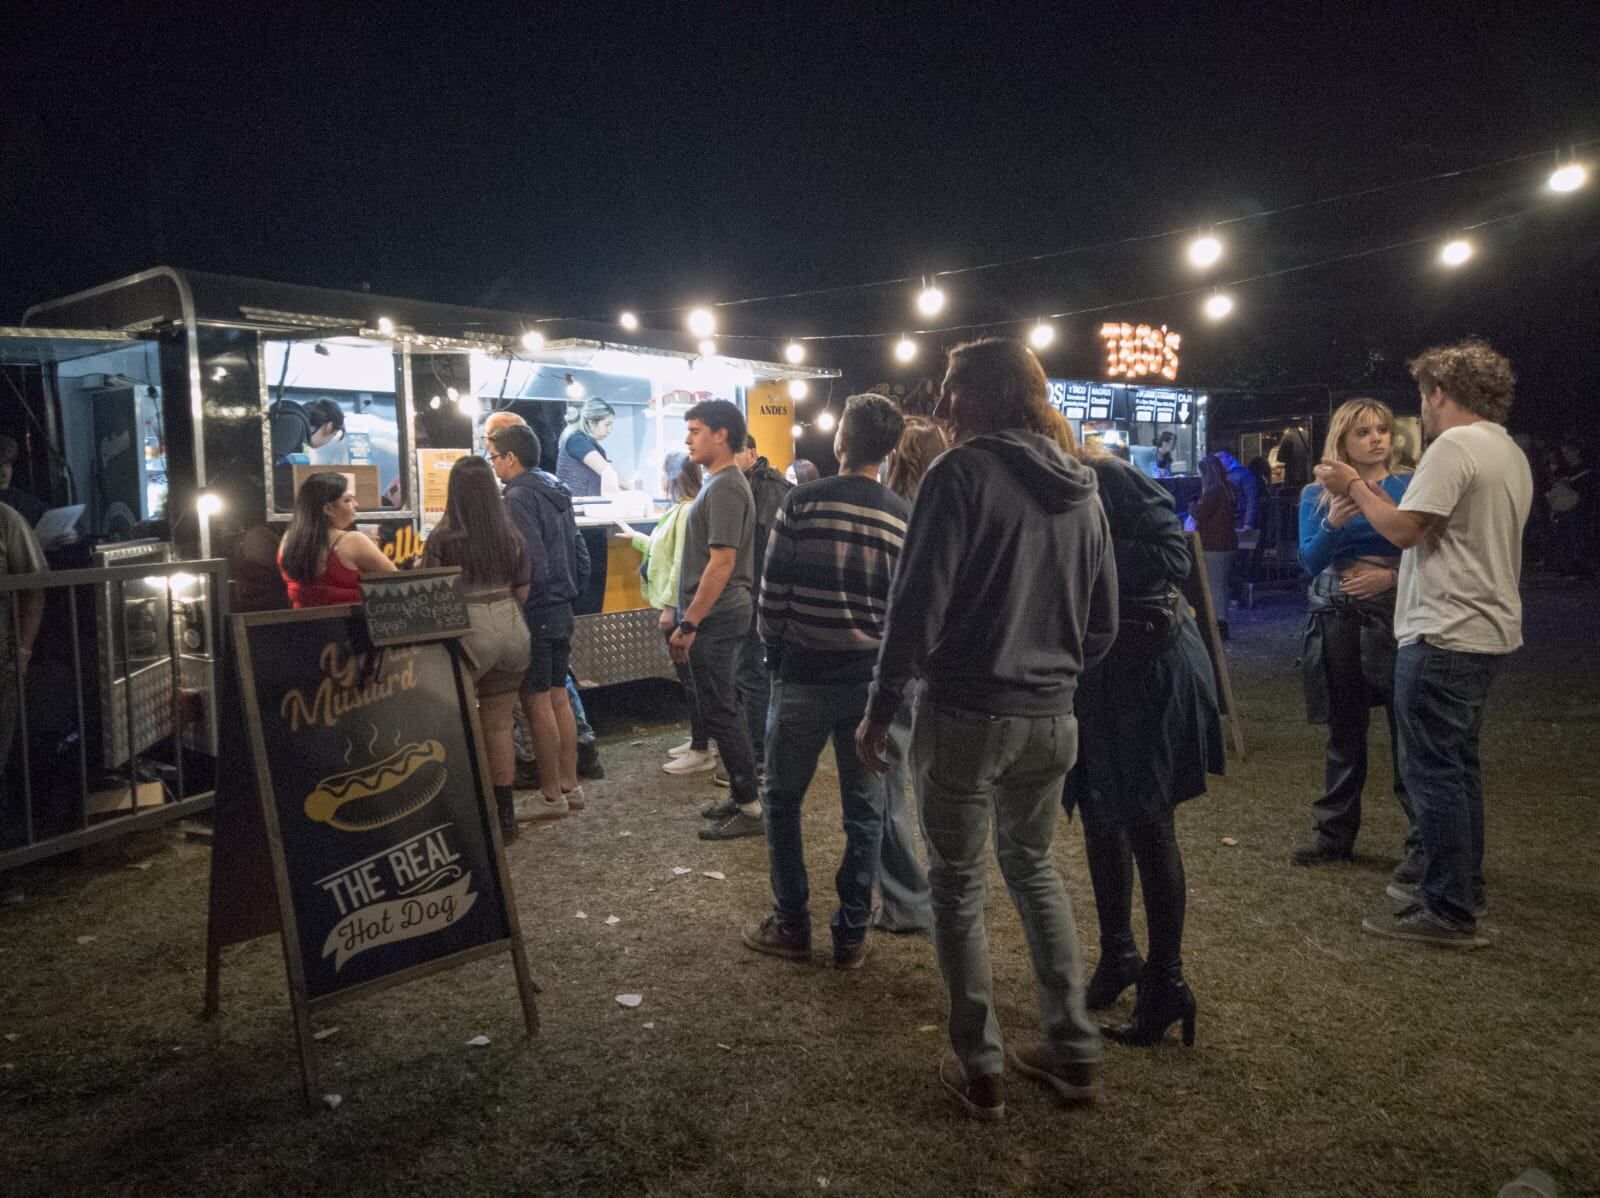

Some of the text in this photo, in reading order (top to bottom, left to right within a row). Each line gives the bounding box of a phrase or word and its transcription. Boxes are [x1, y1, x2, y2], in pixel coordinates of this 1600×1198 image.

[760, 405, 788, 416] ANDES
[322, 831, 461, 915] THE REAL
[338, 895, 456, 951] Hot Dog
